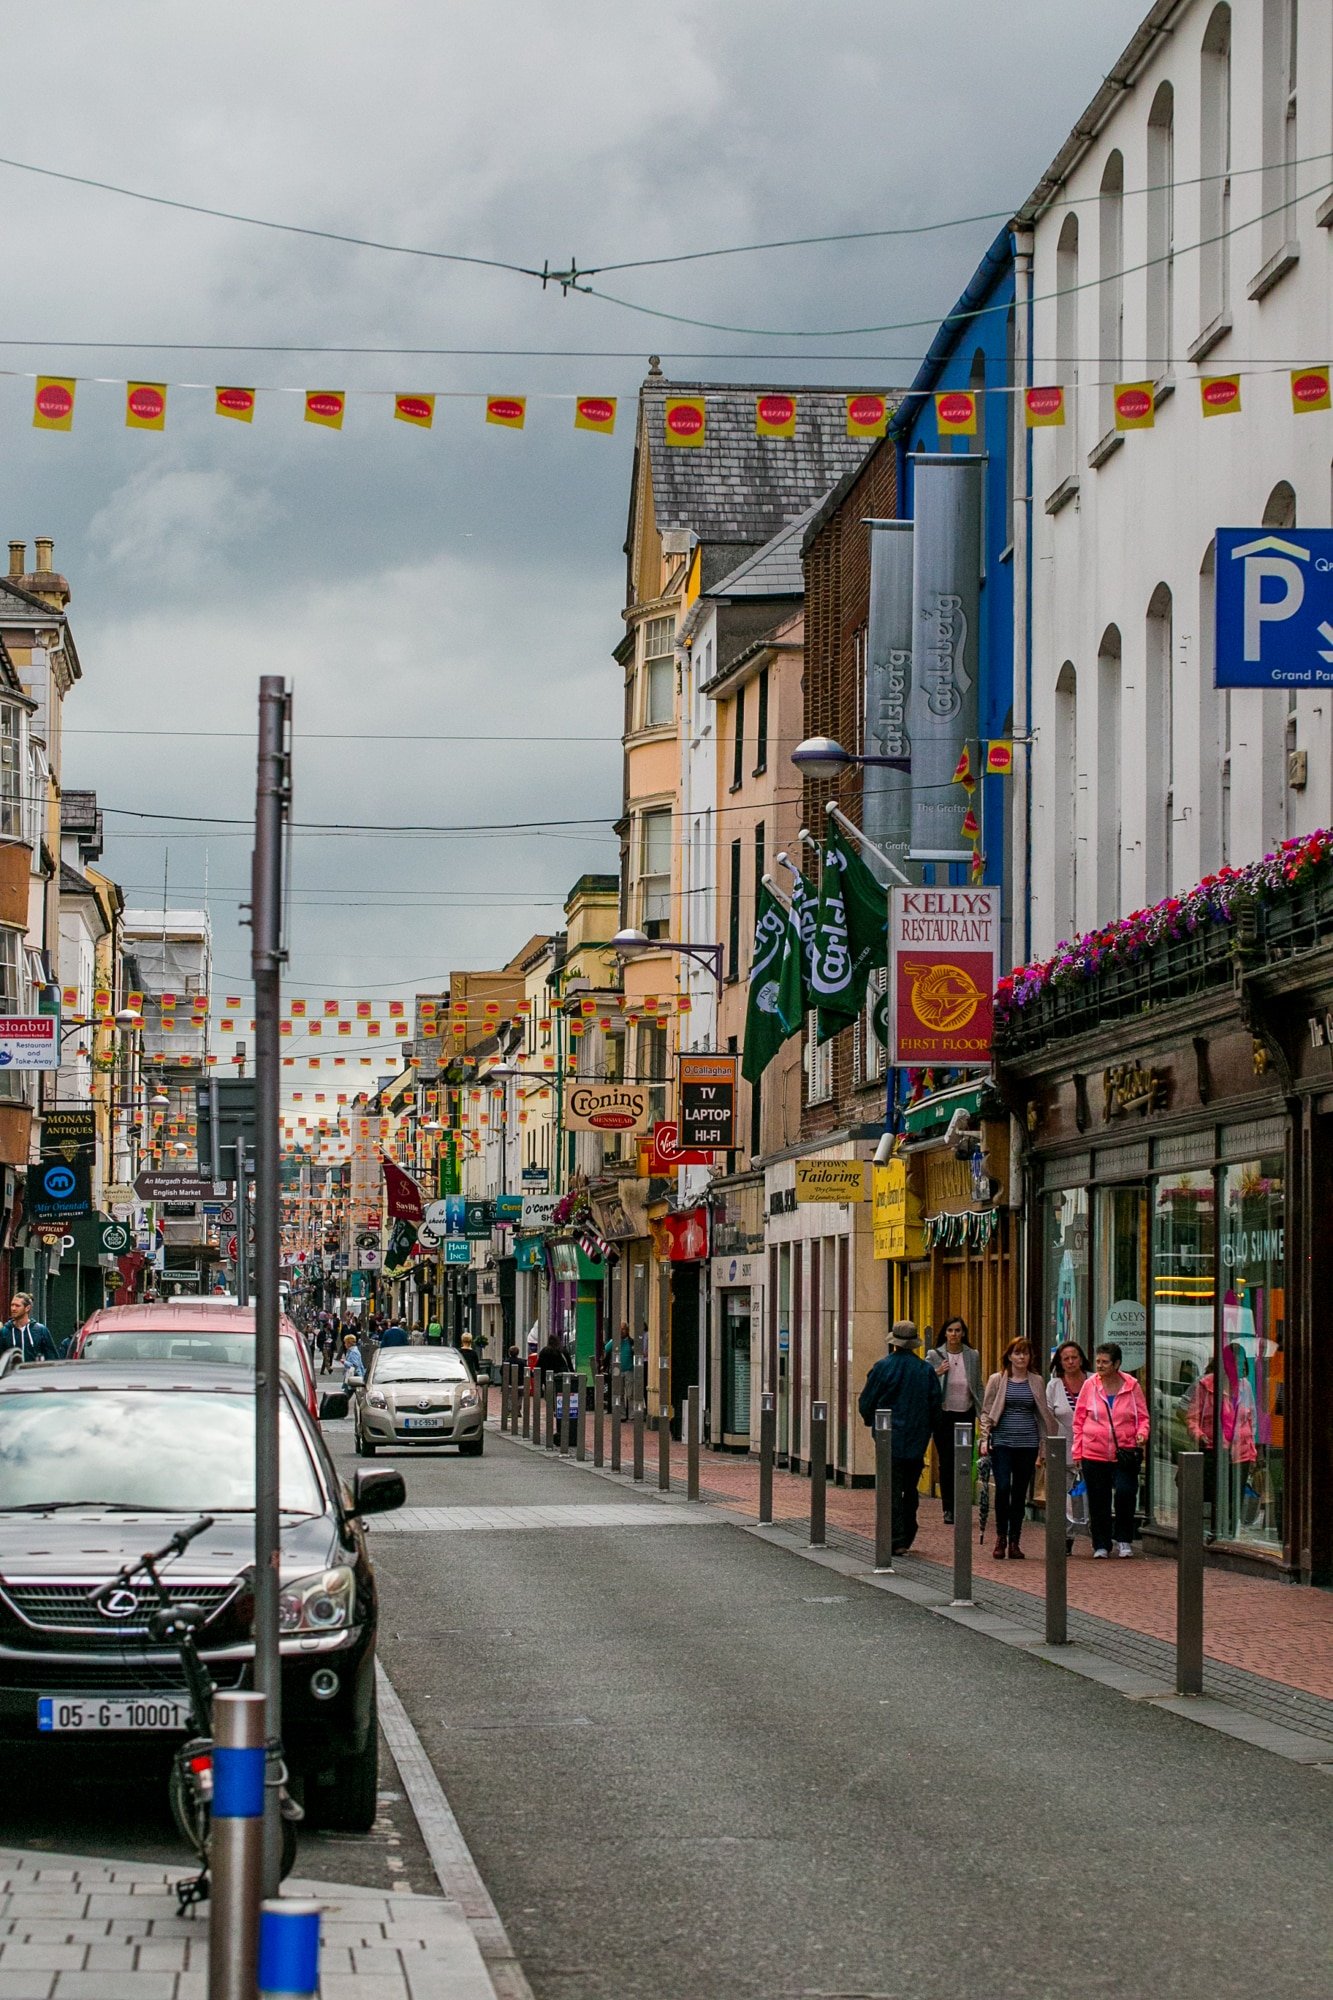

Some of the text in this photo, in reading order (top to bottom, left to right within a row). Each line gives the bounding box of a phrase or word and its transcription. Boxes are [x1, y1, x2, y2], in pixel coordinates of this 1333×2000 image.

[1244, 557, 1304, 661] P
[919, 592, 972, 724] Carlsberg
[1271, 669, 1311, 680] Grand
[917, 803, 967, 813] The Grafto
[901, 893, 991, 916] KELLYS
[901, 917, 991, 942] RESTAURANT
[901, 1038, 988, 1050] FIRST FLOOR
[684, 1066, 732, 1076] O'Callaghan
[700, 1088, 716, 1099] TV
[570, 1088, 644, 1117] Cronins
[47, 1115, 92, 1124] MONA'S
[685, 1109, 731, 1121] LAPTOP
[46, 1127, 93, 1135] ANTIQUES
[695, 1129, 720, 1141] HI-FI
[155, 1178, 180, 1186] Margadh
[798, 1169, 861, 1187] Tailoring
[153, 1189, 177, 1197] English
[52, 1200, 89, 1211] Orientals
[396, 1201, 419, 1212] Saville
[38, 1225, 64, 1233] OPTICIAN
[46, 1234, 56, 1242] 77
[448, 1243, 468, 1251] HAIR
[1251, 1229, 1284, 1262] SUMME
[1110, 1311, 1146, 1322] CASEYS
